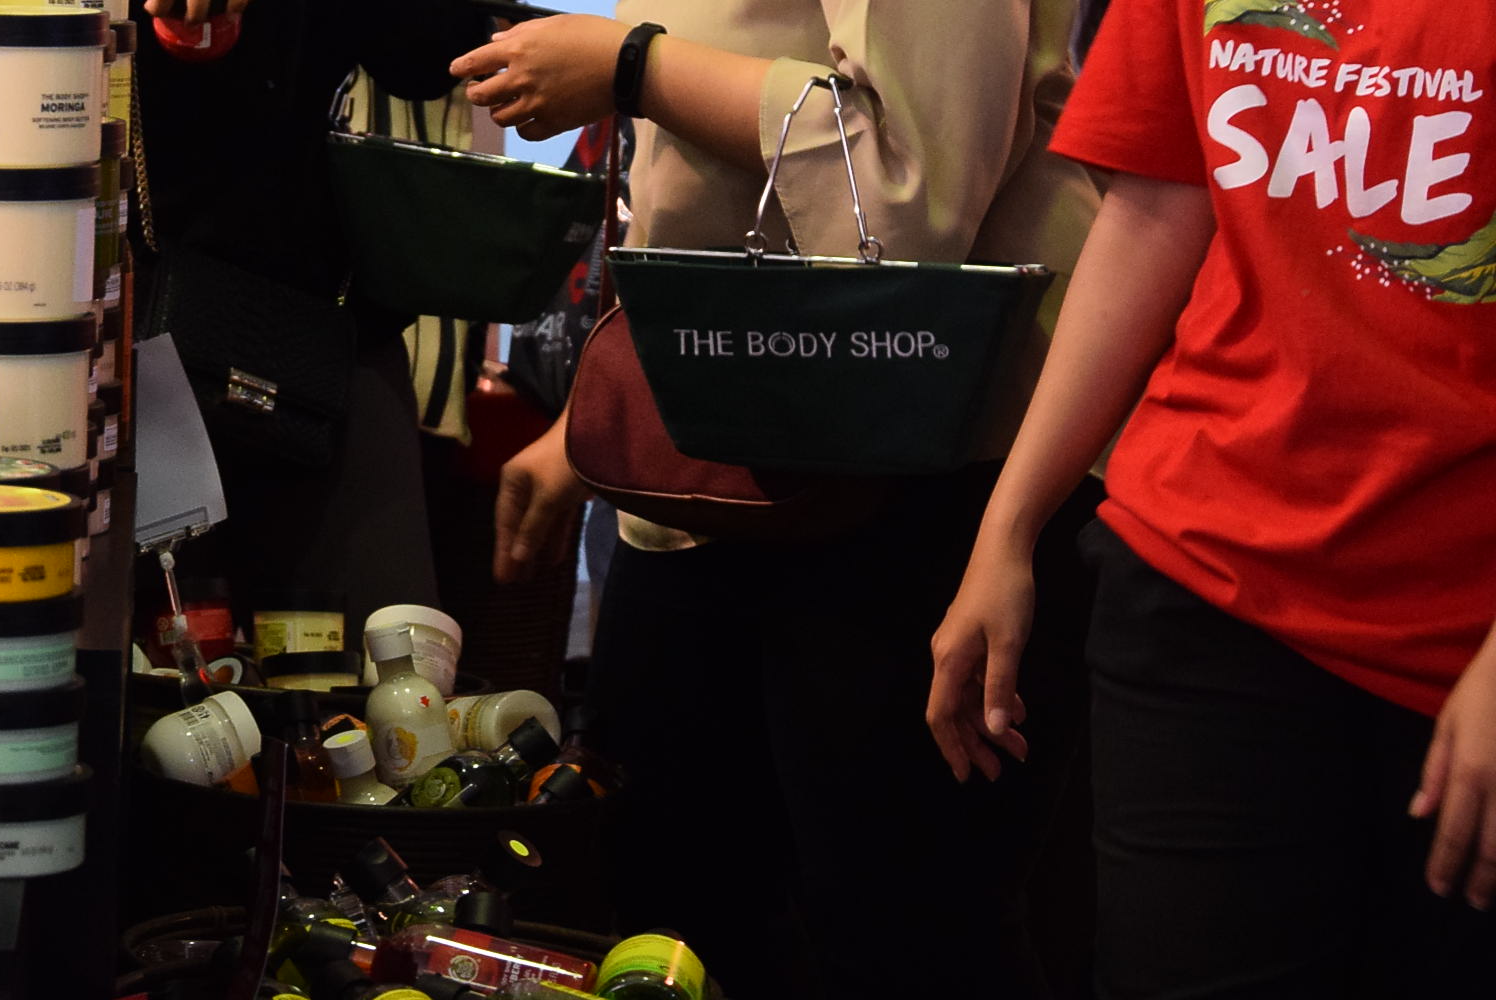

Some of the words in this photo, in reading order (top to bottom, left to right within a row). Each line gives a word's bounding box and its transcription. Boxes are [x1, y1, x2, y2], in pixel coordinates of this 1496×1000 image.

[1208, 39, 1332, 88] NATURE
[1334, 63, 1484, 104] FESTIVAL
[40, 101, 85, 113] MORINGA
[1206, 83, 1473, 226] SALE
[673, 329, 734, 356] THE
[747, 331, 837, 358] BODY
